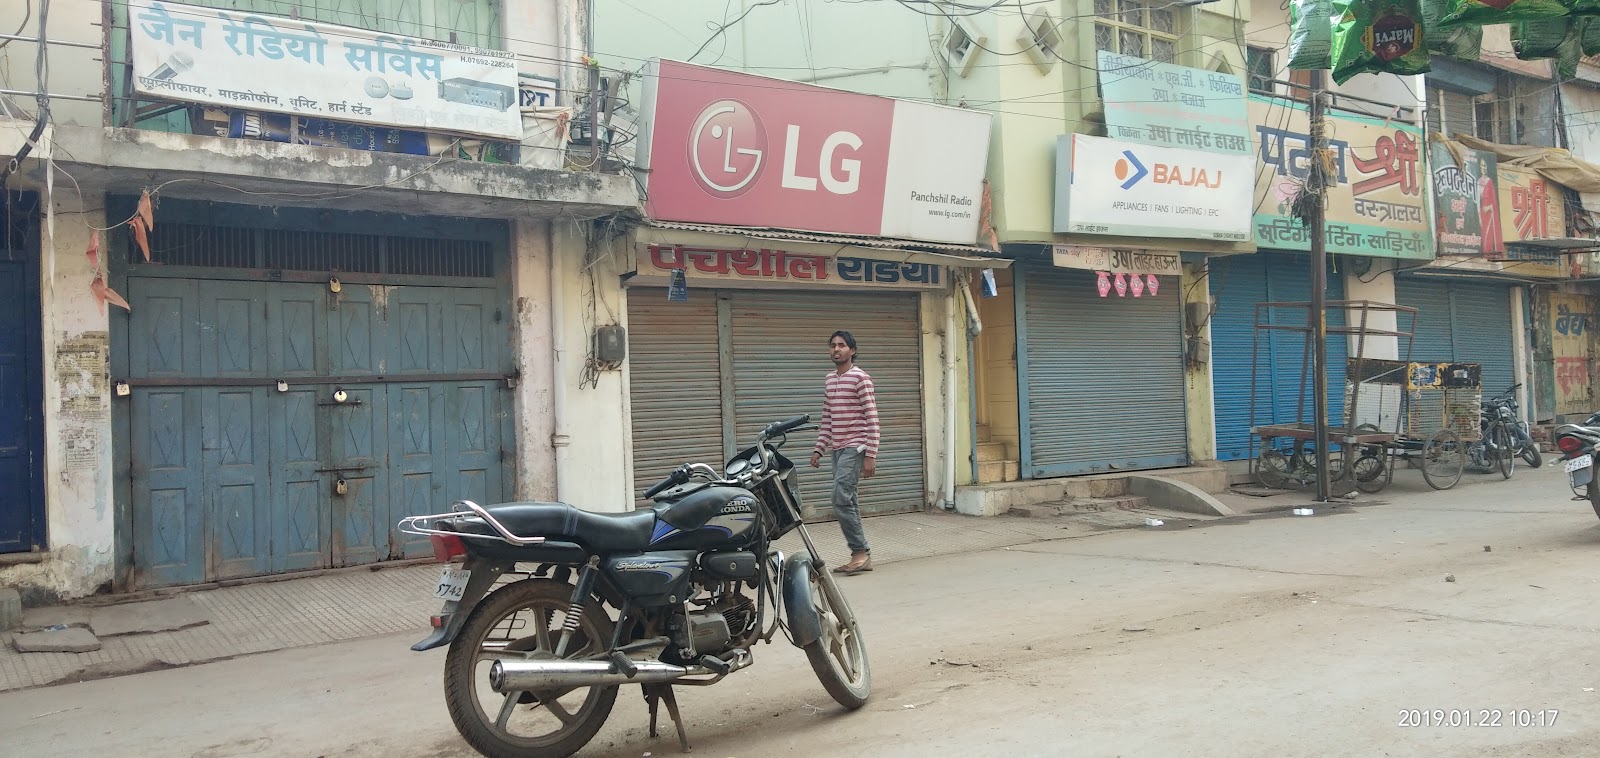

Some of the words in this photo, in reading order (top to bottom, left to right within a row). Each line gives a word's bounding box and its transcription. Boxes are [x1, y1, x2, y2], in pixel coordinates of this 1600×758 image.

[138, 3, 206, 50] जैन
[217, 12, 329, 66] रेडियो
[343, 35, 444, 81] सर्विस
[1376, 28, 1414, 47] Marvi
[1146, 123, 1171, 143] उषा
[781, 123, 863, 195] LG
[1350, 130, 1420, 197] श्री
[1153, 163, 1222, 189] BAJAJ
[910, 190, 949, 204] Panchshil
[950, 194, 972, 206] Radio
[928, 208, 971, 220] www.lg.com/in
[1112, 201, 1148, 212] APPLIANCES
[1154, 204, 1169, 213] FANS
[1175, 205, 1203, 216] LIGHTING
[1208, 208, 1220, 217] EPC
[1354, 198, 1422, 224] वस्त्रालय
[1510, 178, 1550, 240] श्री
[1070, 249, 1081, 258] sky
[1111, 250, 1133, 270] उषा
[724, 499, 747, 507] ERO
[435, 583, 462, 597] 5742
